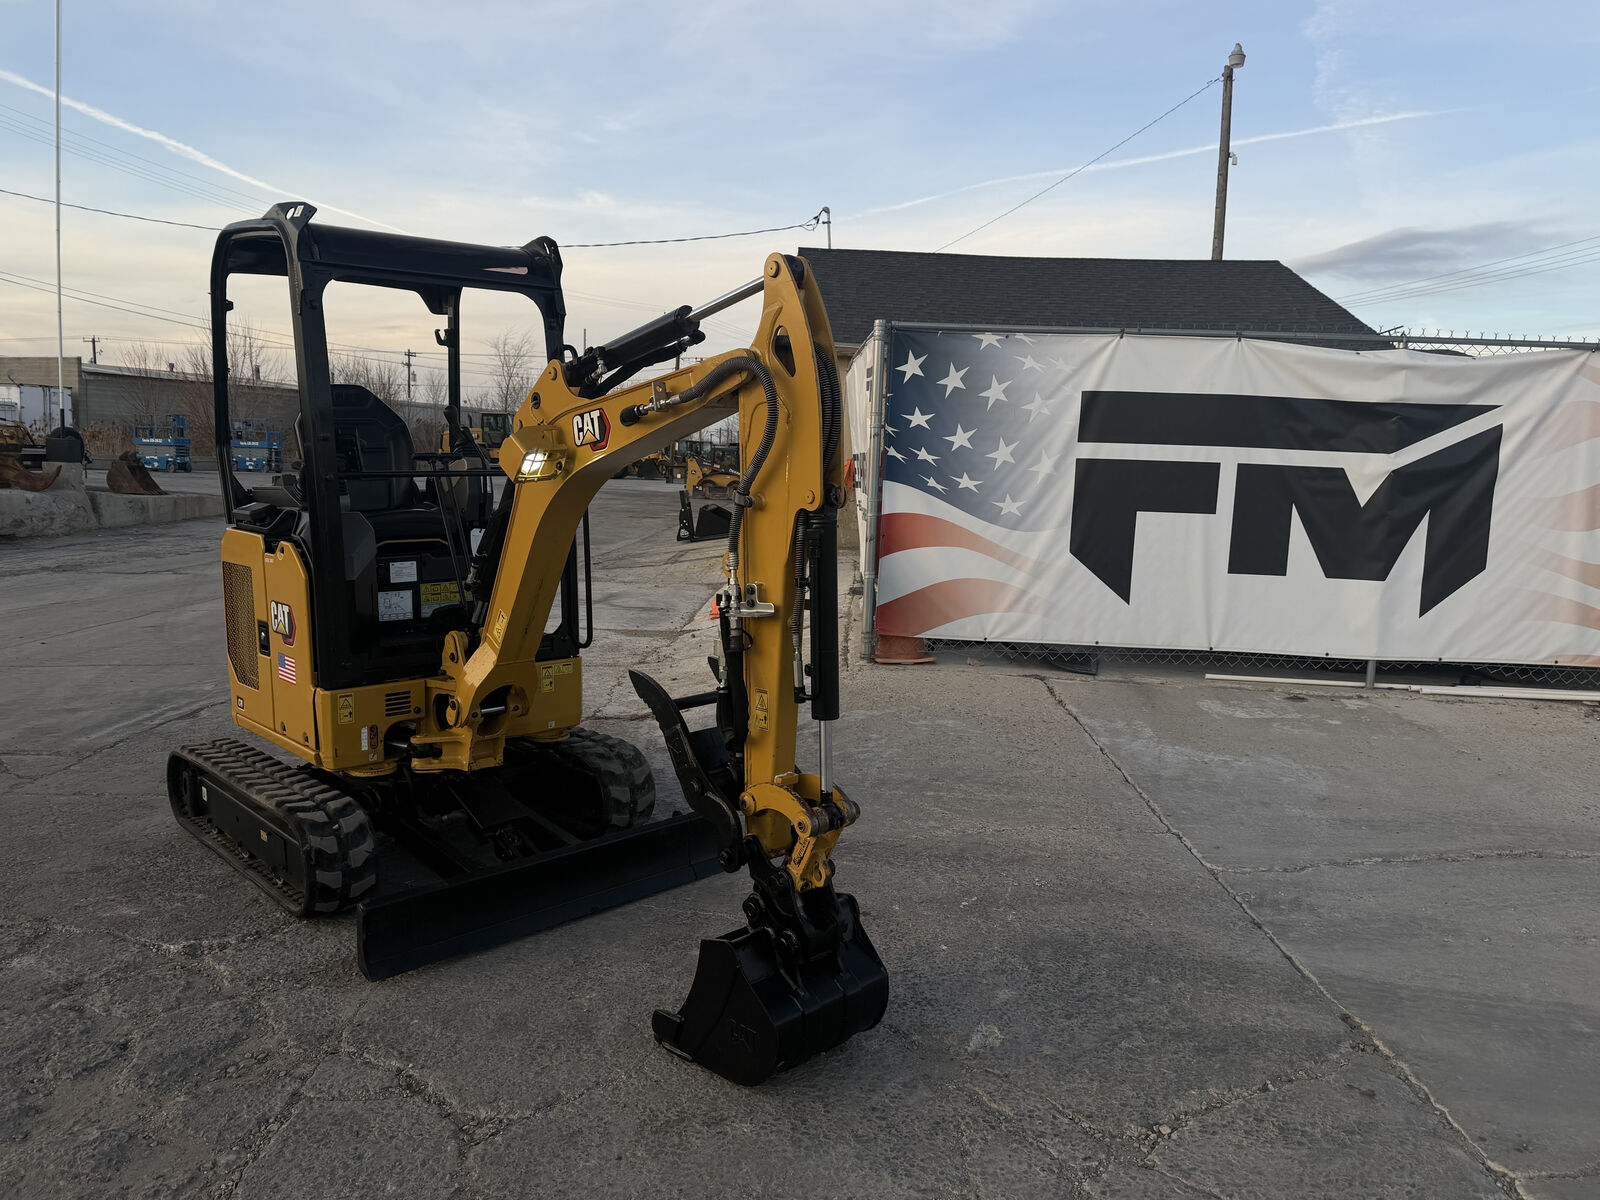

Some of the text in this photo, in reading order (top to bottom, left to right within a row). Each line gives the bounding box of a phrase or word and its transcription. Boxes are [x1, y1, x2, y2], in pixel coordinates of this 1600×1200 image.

[573, 410, 600, 446] CAT
[1070, 391, 1503, 618] FM
[271, 601, 290, 635] CAT
